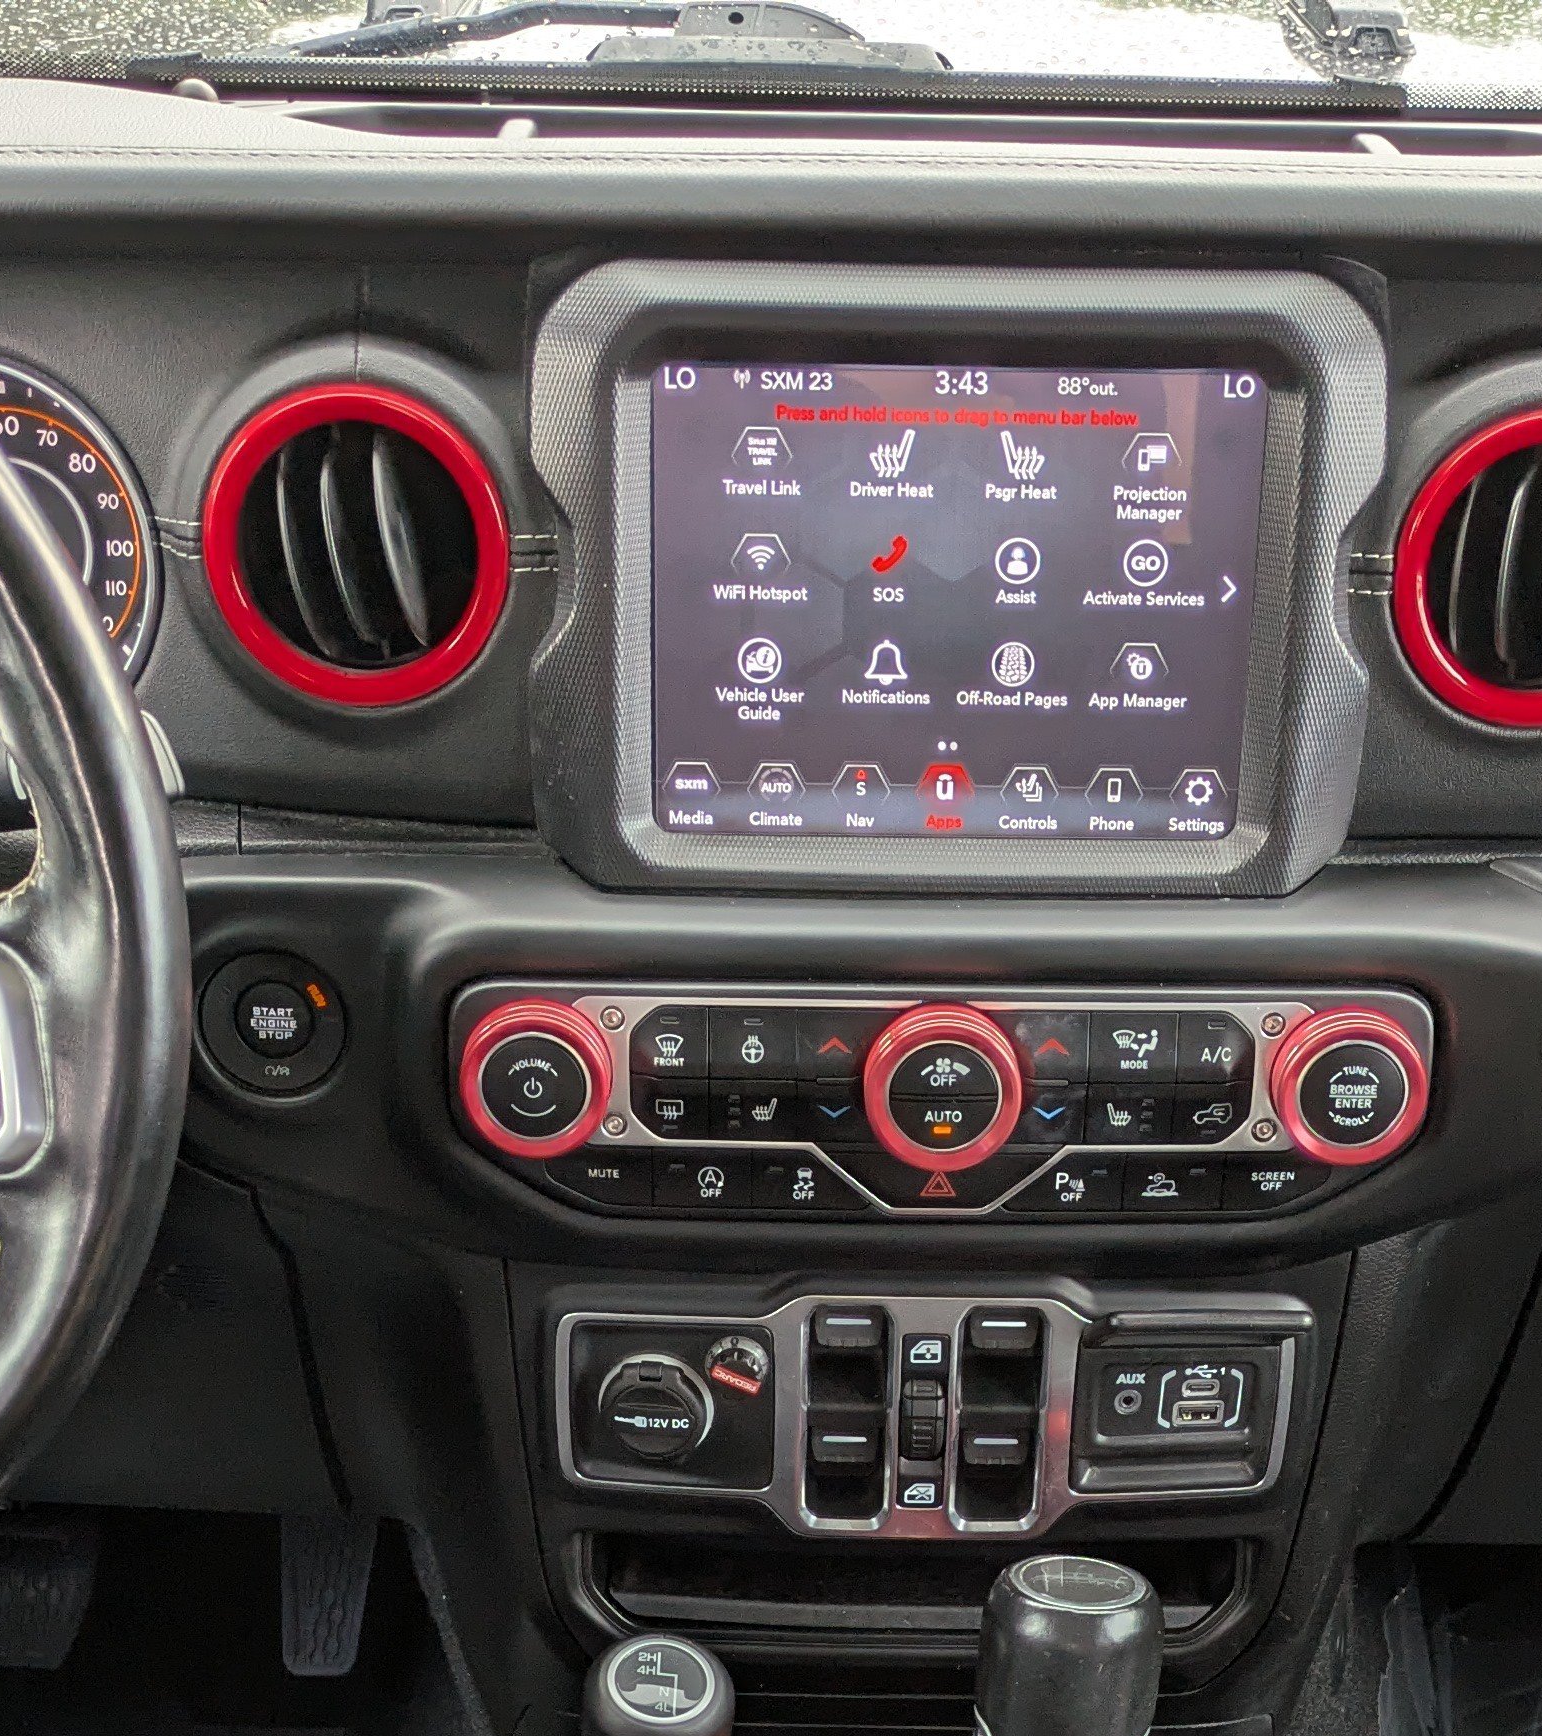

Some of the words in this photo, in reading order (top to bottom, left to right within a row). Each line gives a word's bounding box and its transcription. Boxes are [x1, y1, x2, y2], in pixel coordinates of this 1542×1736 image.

[663, 366, 696, 390] LO
[760, 371, 804, 391] SXM
[808, 372, 834, 391] 23
[934, 371, 989, 396] 3:43
[1223, 374, 1256, 399] LO
[776, 404, 815, 421] Press
[819, 405, 849, 422] and
[853, 405, 887, 422] hold
[892, 407, 930, 423] icons
[935, 408, 950, 424] to
[954, 408, 989, 428] drag
[993, 410, 1008, 425] to
[1013, 411, 1057, 425] menu
[1061, 410, 1086, 426] bar
[36, 429, 59, 448] 70
[68, 453, 96, 474] 80
[723, 479, 767, 496] Travel
[771, 480, 801, 497] Link
[850, 481, 894, 497] Driver
[897, 482, 934, 498] Heat
[985, 484, 1018, 502] Psgr
[1021, 485, 1057, 500] Heat
[1113, 486, 1187, 505] Projection
[97, 493, 120, 510] 90
[1116, 505, 1182, 523] Manager
[105, 539, 134, 557] 100
[1130, 554, 1161, 571] GO
[105, 580, 127, 597] 110
[713, 584, 746, 600] WiFi
[749, 585, 808, 603] Hotspot
[873, 588, 904, 602] SOS
[995, 589, 1037, 605] Assist
[1083, 591, 1142, 606] Activate
[1146, 591, 1205, 607] Services
[715, 687, 767, 703] Vehicle
[771, 688, 805, 704] User
[842, 689, 930, 705] Notifications
[956, 690, 1021, 706] Off-Road
[1024, 692, 1068, 709] Pages
[1088, 693, 1119, 710] App
[1123, 694, 1188, 710] Manager
[737, 706, 781, 721] Guide
[674, 778, 708, 790] sxm
[761, 782, 792, 794] AUTO
[669, 811, 713, 826] Media
[749, 812, 803, 827] Climate
[846, 813, 875, 827] Nav
[926, 814, 962, 829] Apps
[999, 815, 1058, 831] Controls
[1089, 817, 1135, 831] Phone
[1169, 818, 1225, 834] Settings
[252, 1006, 294, 1017] START
[250, 1018, 297, 1029] ENGINE
[259, 1031, 293, 1040] STOP
[654, 1056, 685, 1067] FRONT
[1200, 1047, 1232, 1063] A/C
[512, 1059, 553, 1073] VOLUME
[1120, 1060, 1149, 1070] MODE
[1343, 1066, 1369, 1077] TUNE
[929, 1074, 957, 1087] OFF
[1329, 1084, 1378, 1095] BROWSE
[1335, 1098, 1372, 1109] ENTER
[924, 1110, 962, 1123] AUTO
[1333, 1112, 1372, 1127] SCROLL
[587, 1168, 620, 1180] MUTE
[1251, 1171, 1295, 1182] SCREEN
[700, 1187, 722, 1199] OFF
[1260, 1181, 1283, 1191] OFF
[792, 1189, 815, 1201] OFF
[1060, 1192, 1083, 1202] OFF
[1116, 1373, 1146, 1384] AUX
[647, 1417, 669, 1429] 12V
[671, 1418, 690, 1429] DC
[638, 1652, 657, 1663] 2H
[636, 1665, 657, 1676] 4H
[659, 1686, 670, 1698] N
[654, 1702, 671, 1714] 4L
